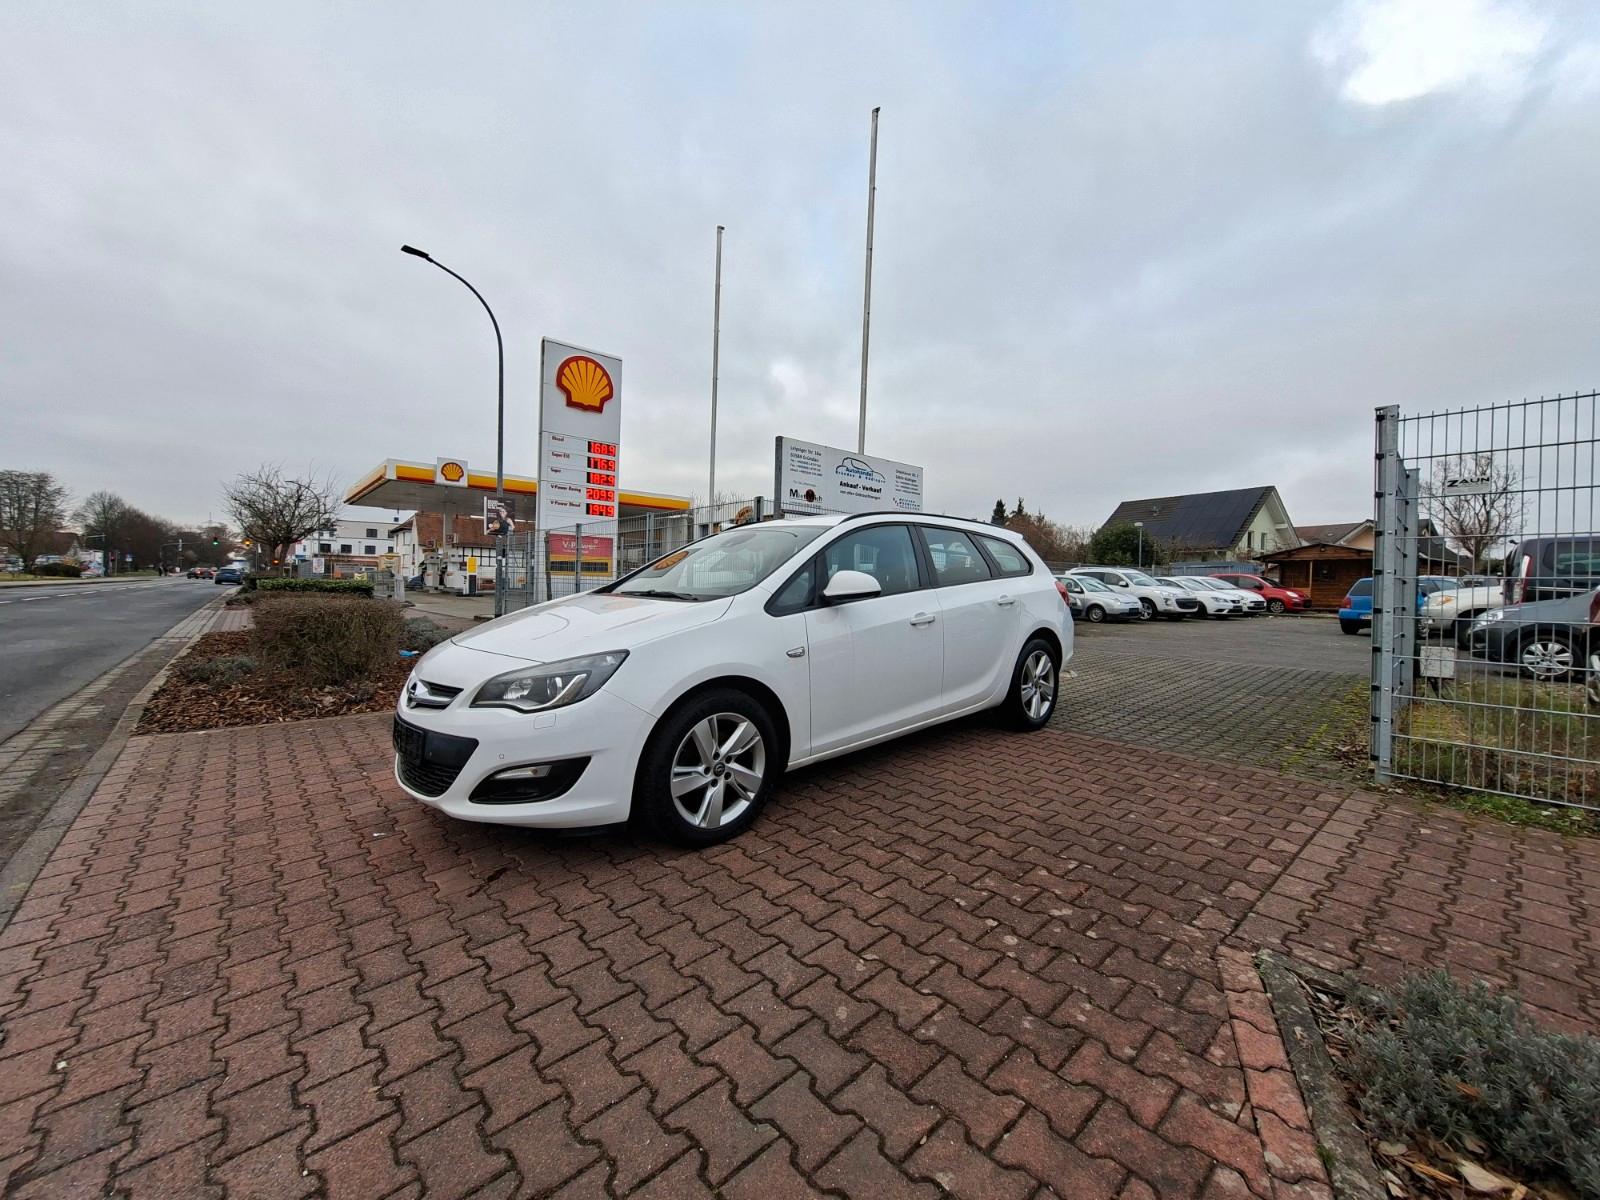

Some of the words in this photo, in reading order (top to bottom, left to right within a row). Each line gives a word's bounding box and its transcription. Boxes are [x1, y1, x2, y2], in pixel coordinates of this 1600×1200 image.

[591, 457, 615, 471] 1769
[591, 473, 614, 487] 1829
[1447, 477, 1490, 487] ZAUN
[840, 481, 858, 489] Ankauf
[862, 485, 882, 493] Verkauf
[586, 488, 614, 502] 2099
[590, 504, 614, 517] 1949
